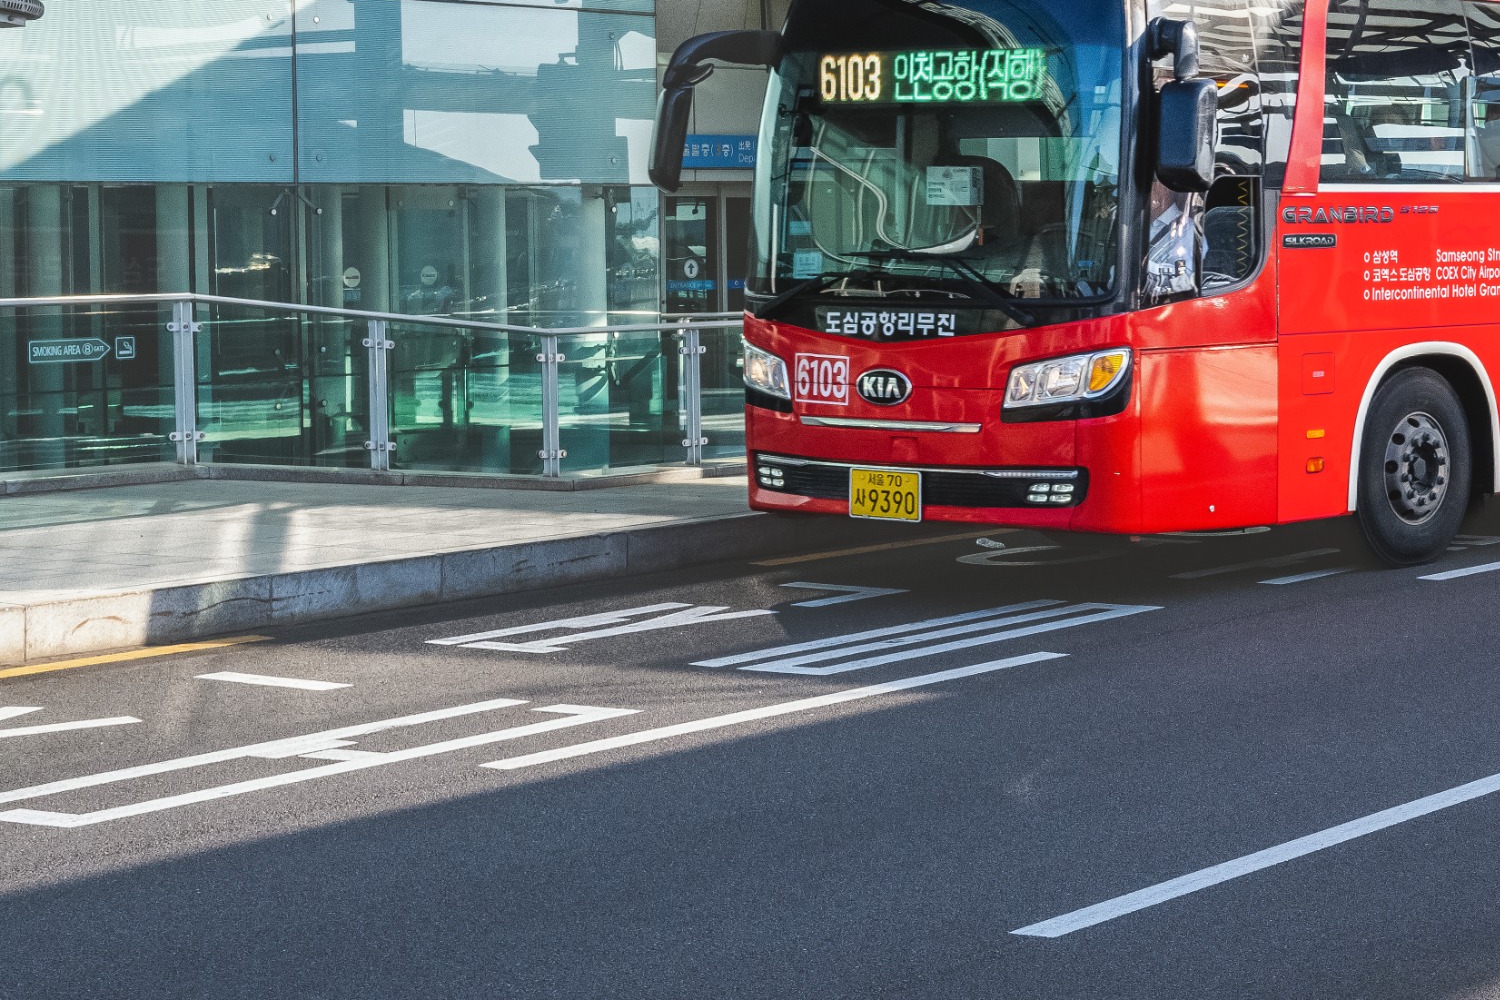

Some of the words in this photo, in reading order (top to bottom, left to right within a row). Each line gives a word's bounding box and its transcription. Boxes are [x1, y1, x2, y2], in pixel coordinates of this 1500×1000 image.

[820, 54, 881, 101] 6103
[1281, 205, 1395, 224] GRANBIRD
[1285, 236, 1335, 246] SILKROAD
[1373, 250, 1398, 264] 삼성역
[1436, 249, 1485, 264] Samseong
[1436, 266, 1459, 280] COEX
[1461, 265, 1477, 281] City
[1372, 285, 1450, 301] Intercontinental
[1452, 284, 1477, 298] Hotel
[825, 311, 956, 337] 도심공항리무진
[32, 345, 62, 357] SMOKING
[63, 344, 81, 355] AREA
[797, 358, 847, 399] 6103
[862, 376, 902, 399] KIA
[868, 473, 885, 486] 서울
[887, 474, 903, 488] 70
